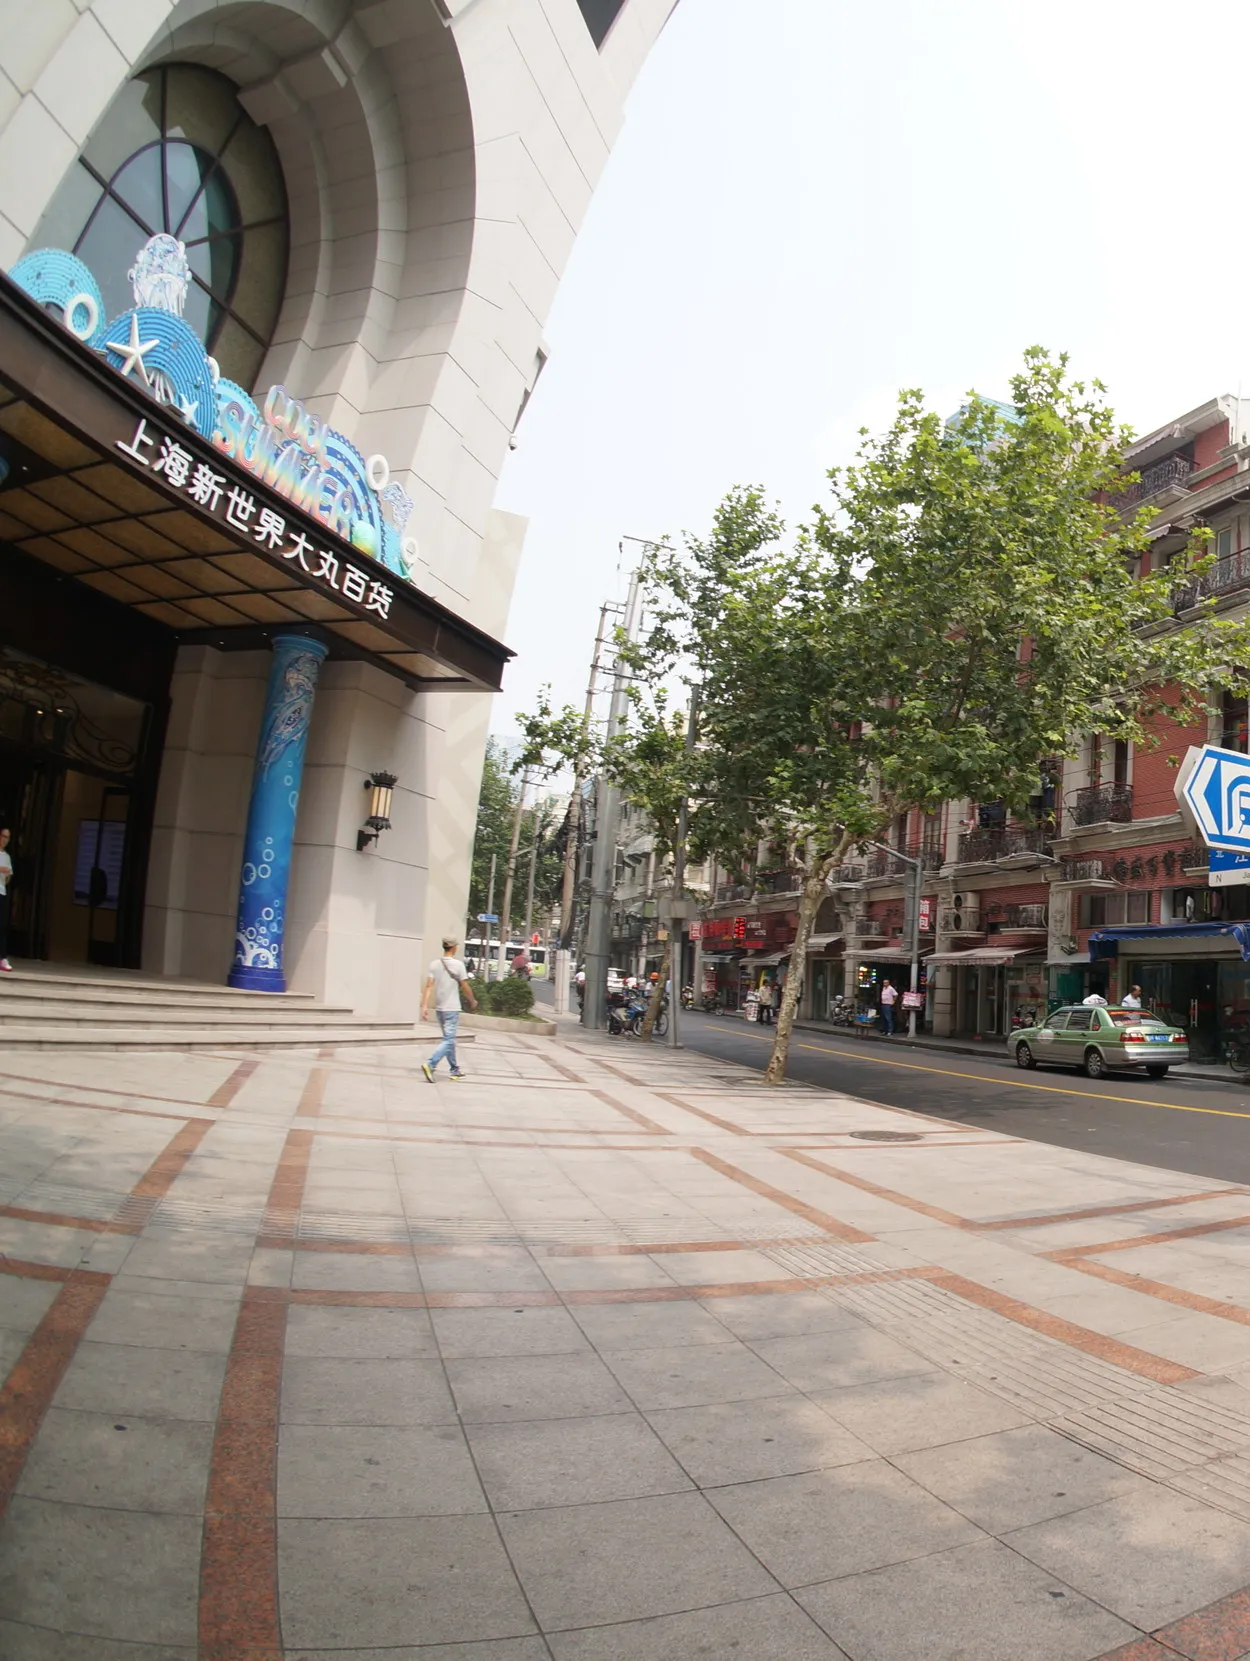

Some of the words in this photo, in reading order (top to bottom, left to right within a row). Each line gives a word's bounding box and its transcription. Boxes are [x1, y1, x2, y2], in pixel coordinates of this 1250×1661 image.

[114, 418, 394, 620] 上海新世界大丸百货
[212, 401, 353, 541] SUMMER
